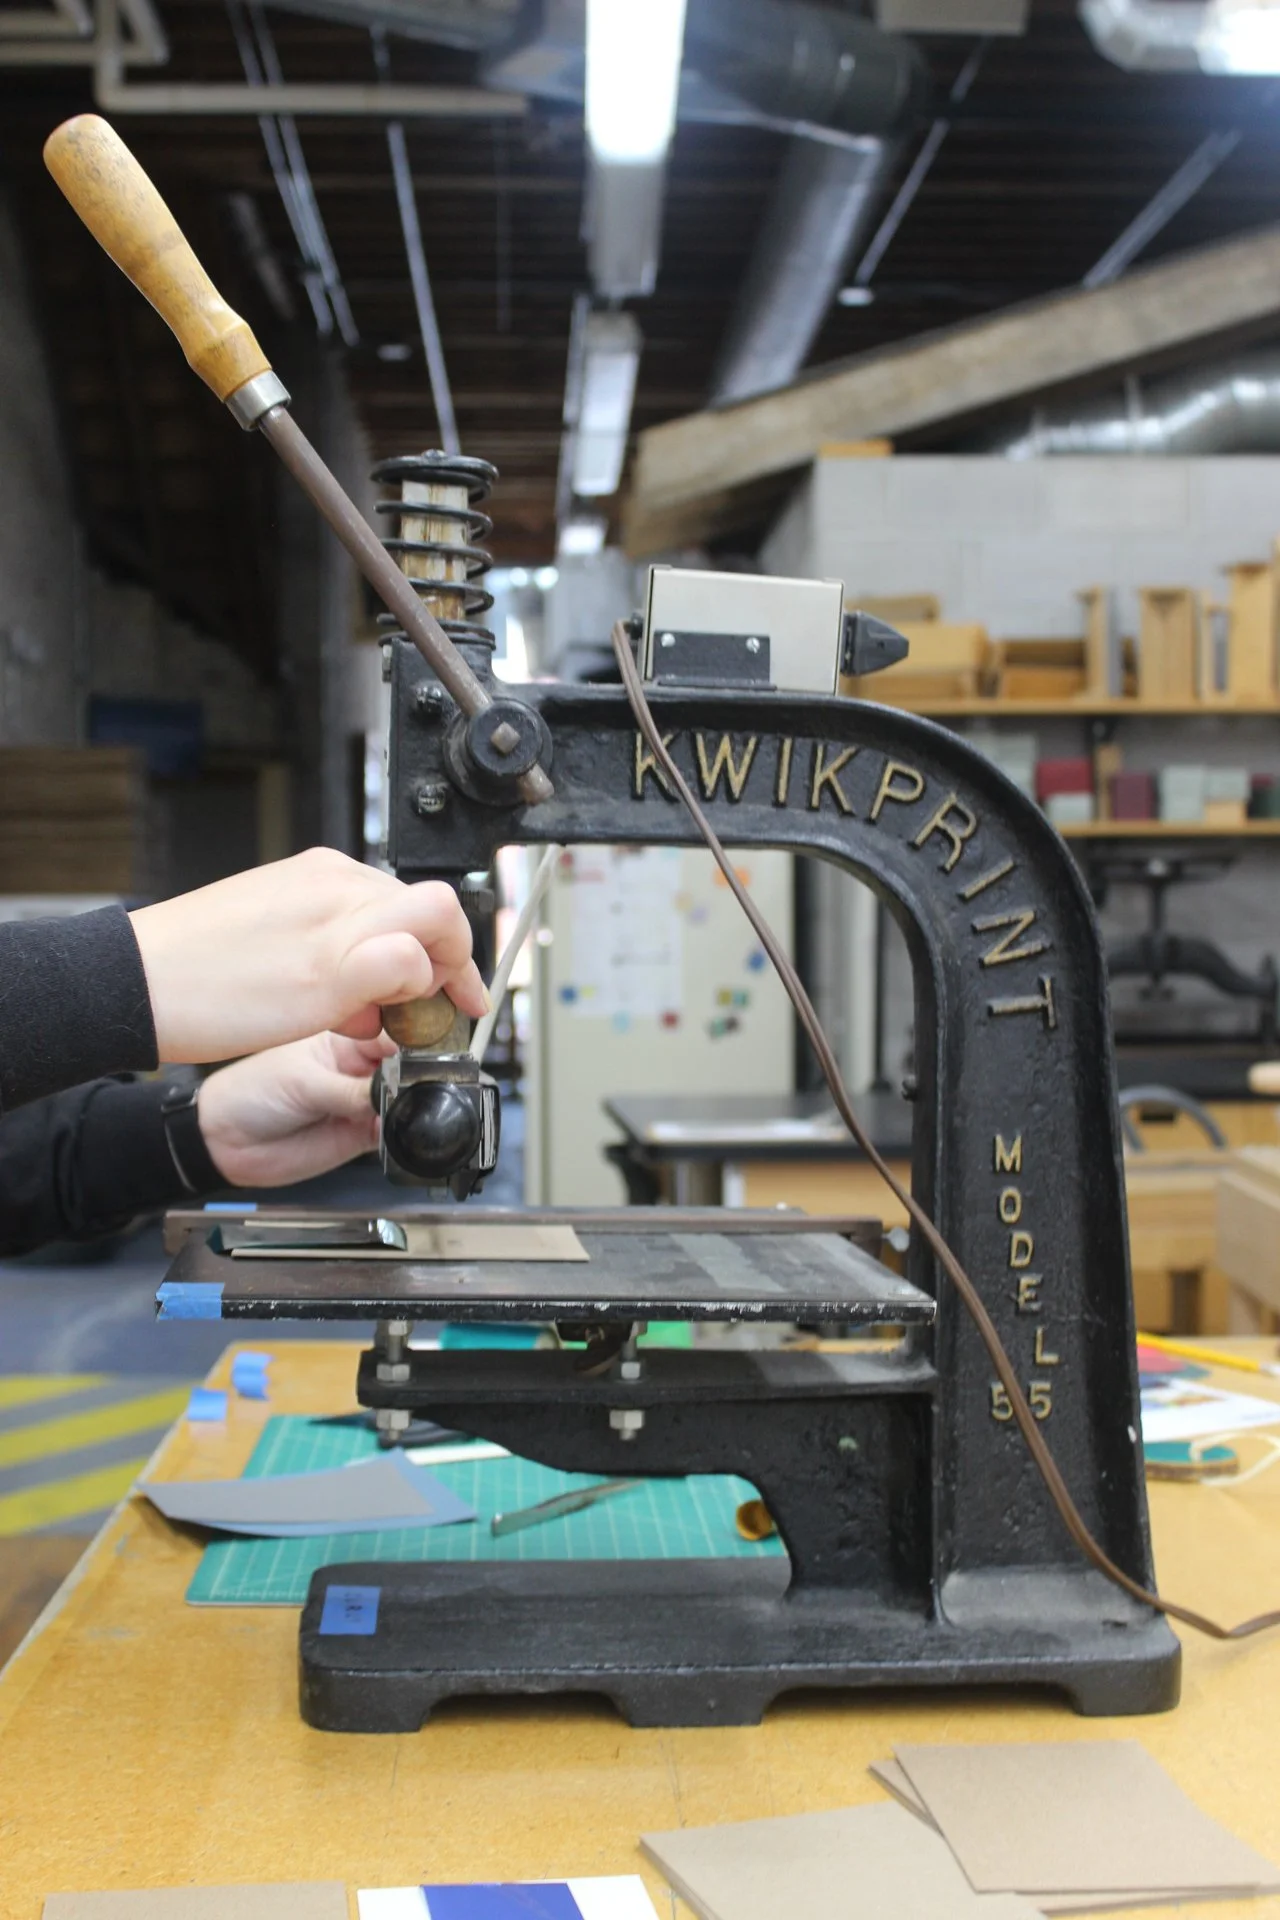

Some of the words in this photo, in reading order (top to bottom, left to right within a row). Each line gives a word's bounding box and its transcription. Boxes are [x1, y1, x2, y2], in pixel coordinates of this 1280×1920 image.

[633, 732, 1056, 1027] KWIKPRINT
[995, 1133, 1058, 1365] MODEL
[992, 1381, 1052, 1420] 55
